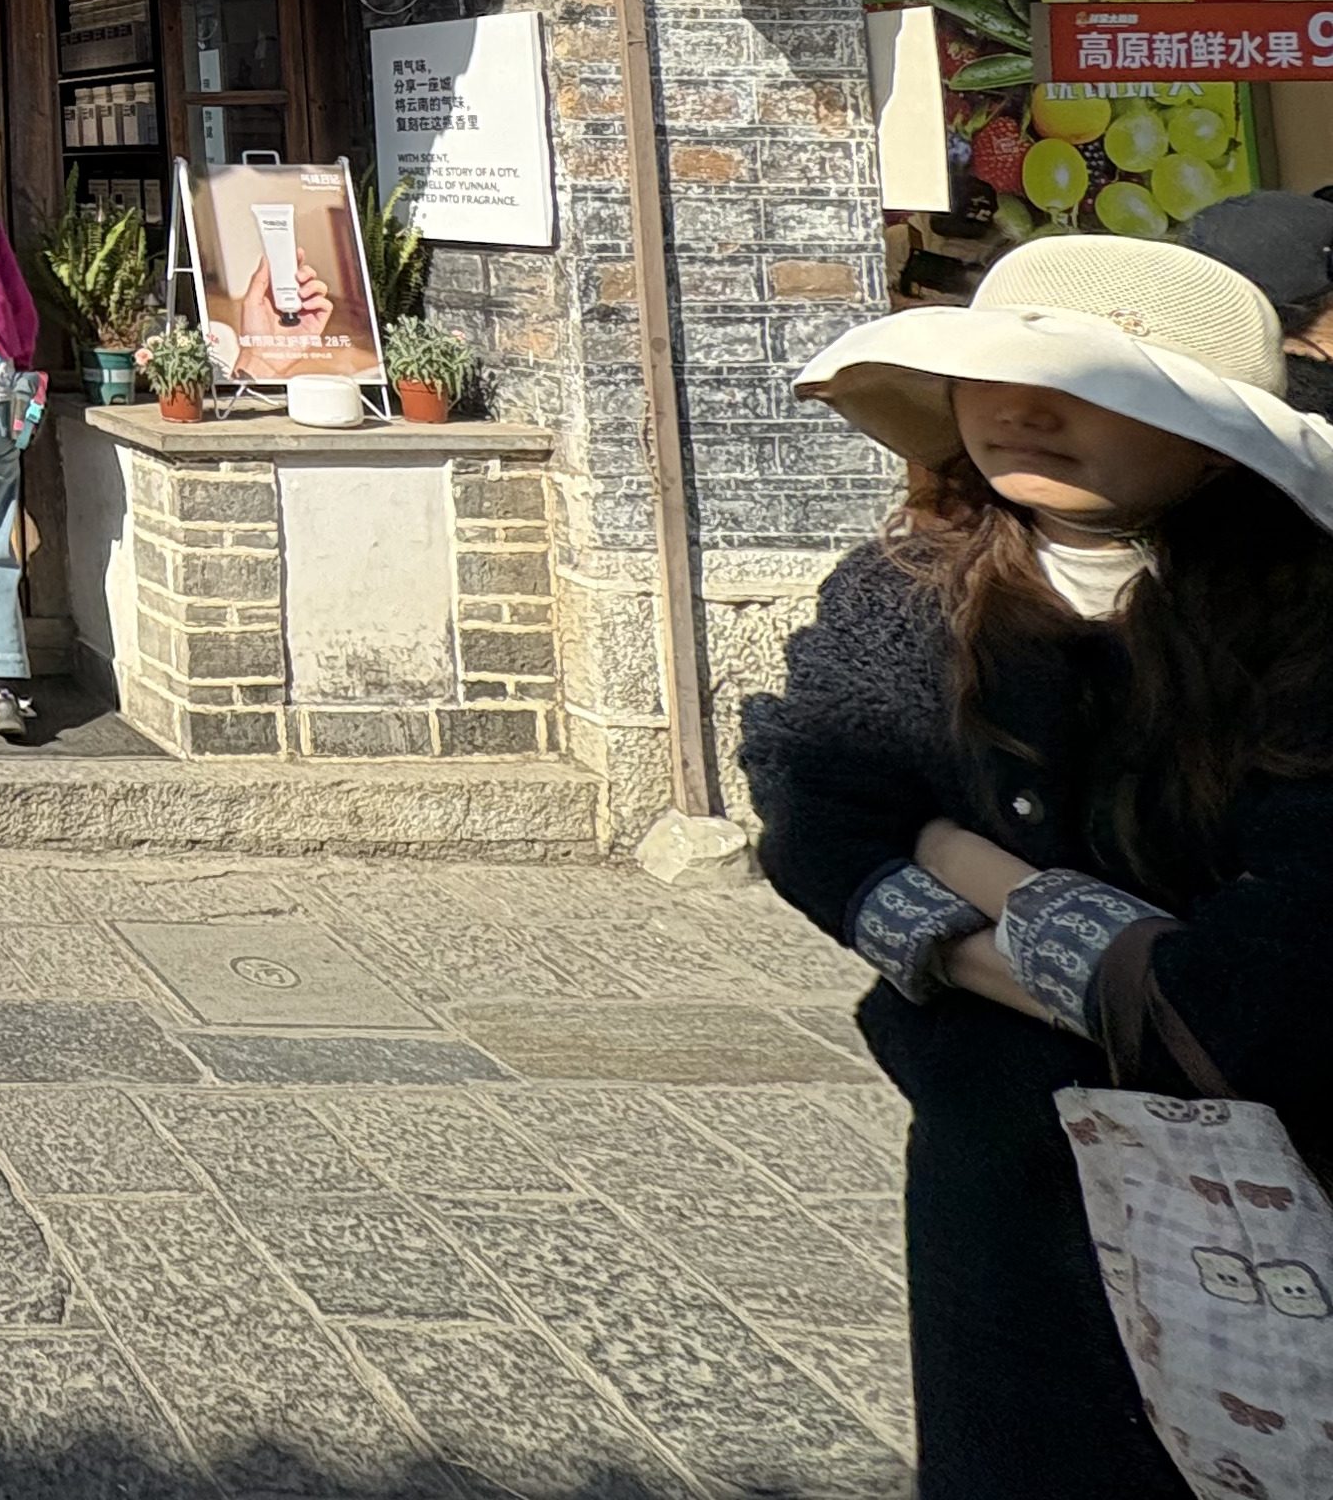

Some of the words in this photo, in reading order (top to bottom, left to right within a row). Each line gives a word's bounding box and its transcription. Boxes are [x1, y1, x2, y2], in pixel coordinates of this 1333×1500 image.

[1077, 30, 1304, 69] 高原新鲜水果
[397, 153, 419, 162] WITH
[446, 167, 473, 177] STORY
[475, 167, 487, 177] OF
[489, 168, 496, 177] A
[445, 180, 456, 190] OF
[439, 194, 460, 204] INTO
